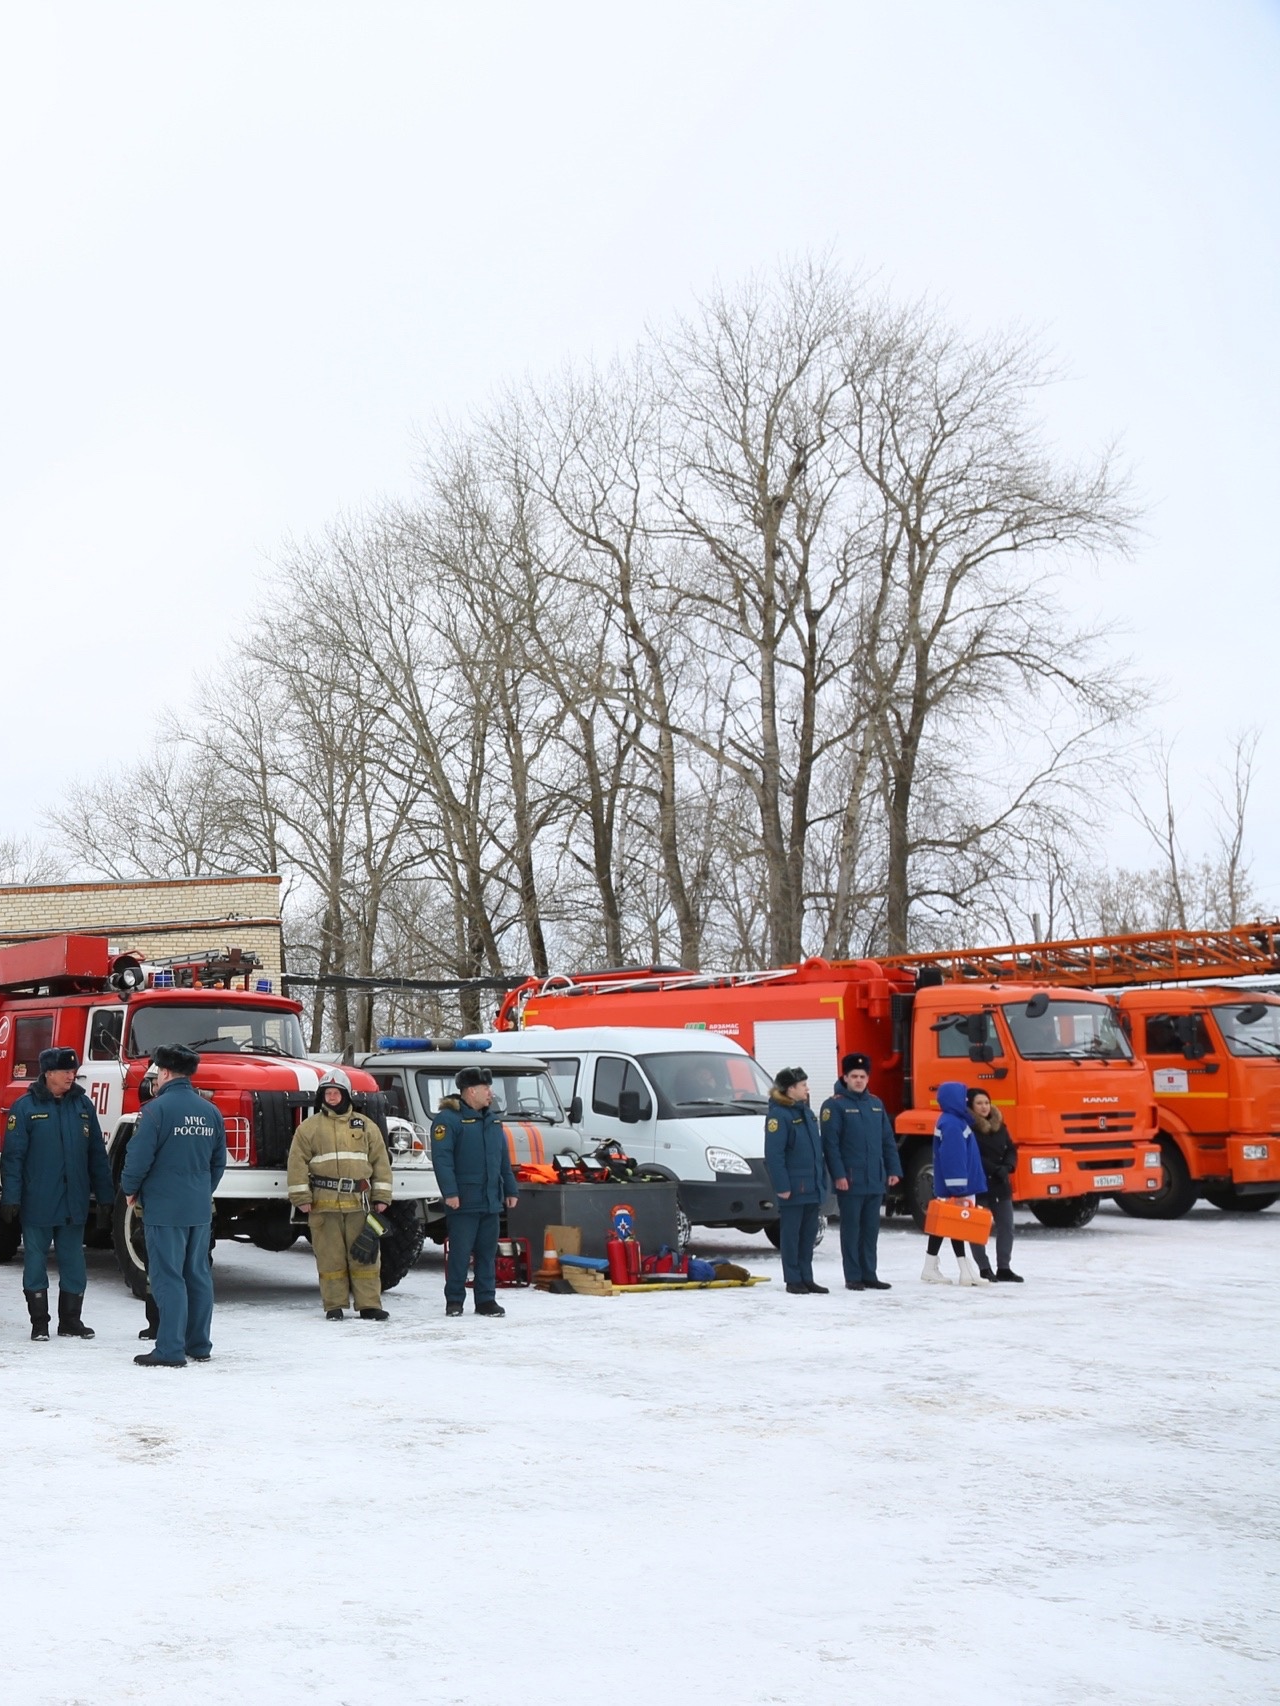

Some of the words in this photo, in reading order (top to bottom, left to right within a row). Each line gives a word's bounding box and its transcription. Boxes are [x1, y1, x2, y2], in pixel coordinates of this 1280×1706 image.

[90, 1083, 110, 1115] 50
[184, 1115, 206, 1126] МЧС
[173, 1126, 214, 1137] РОССИИ
